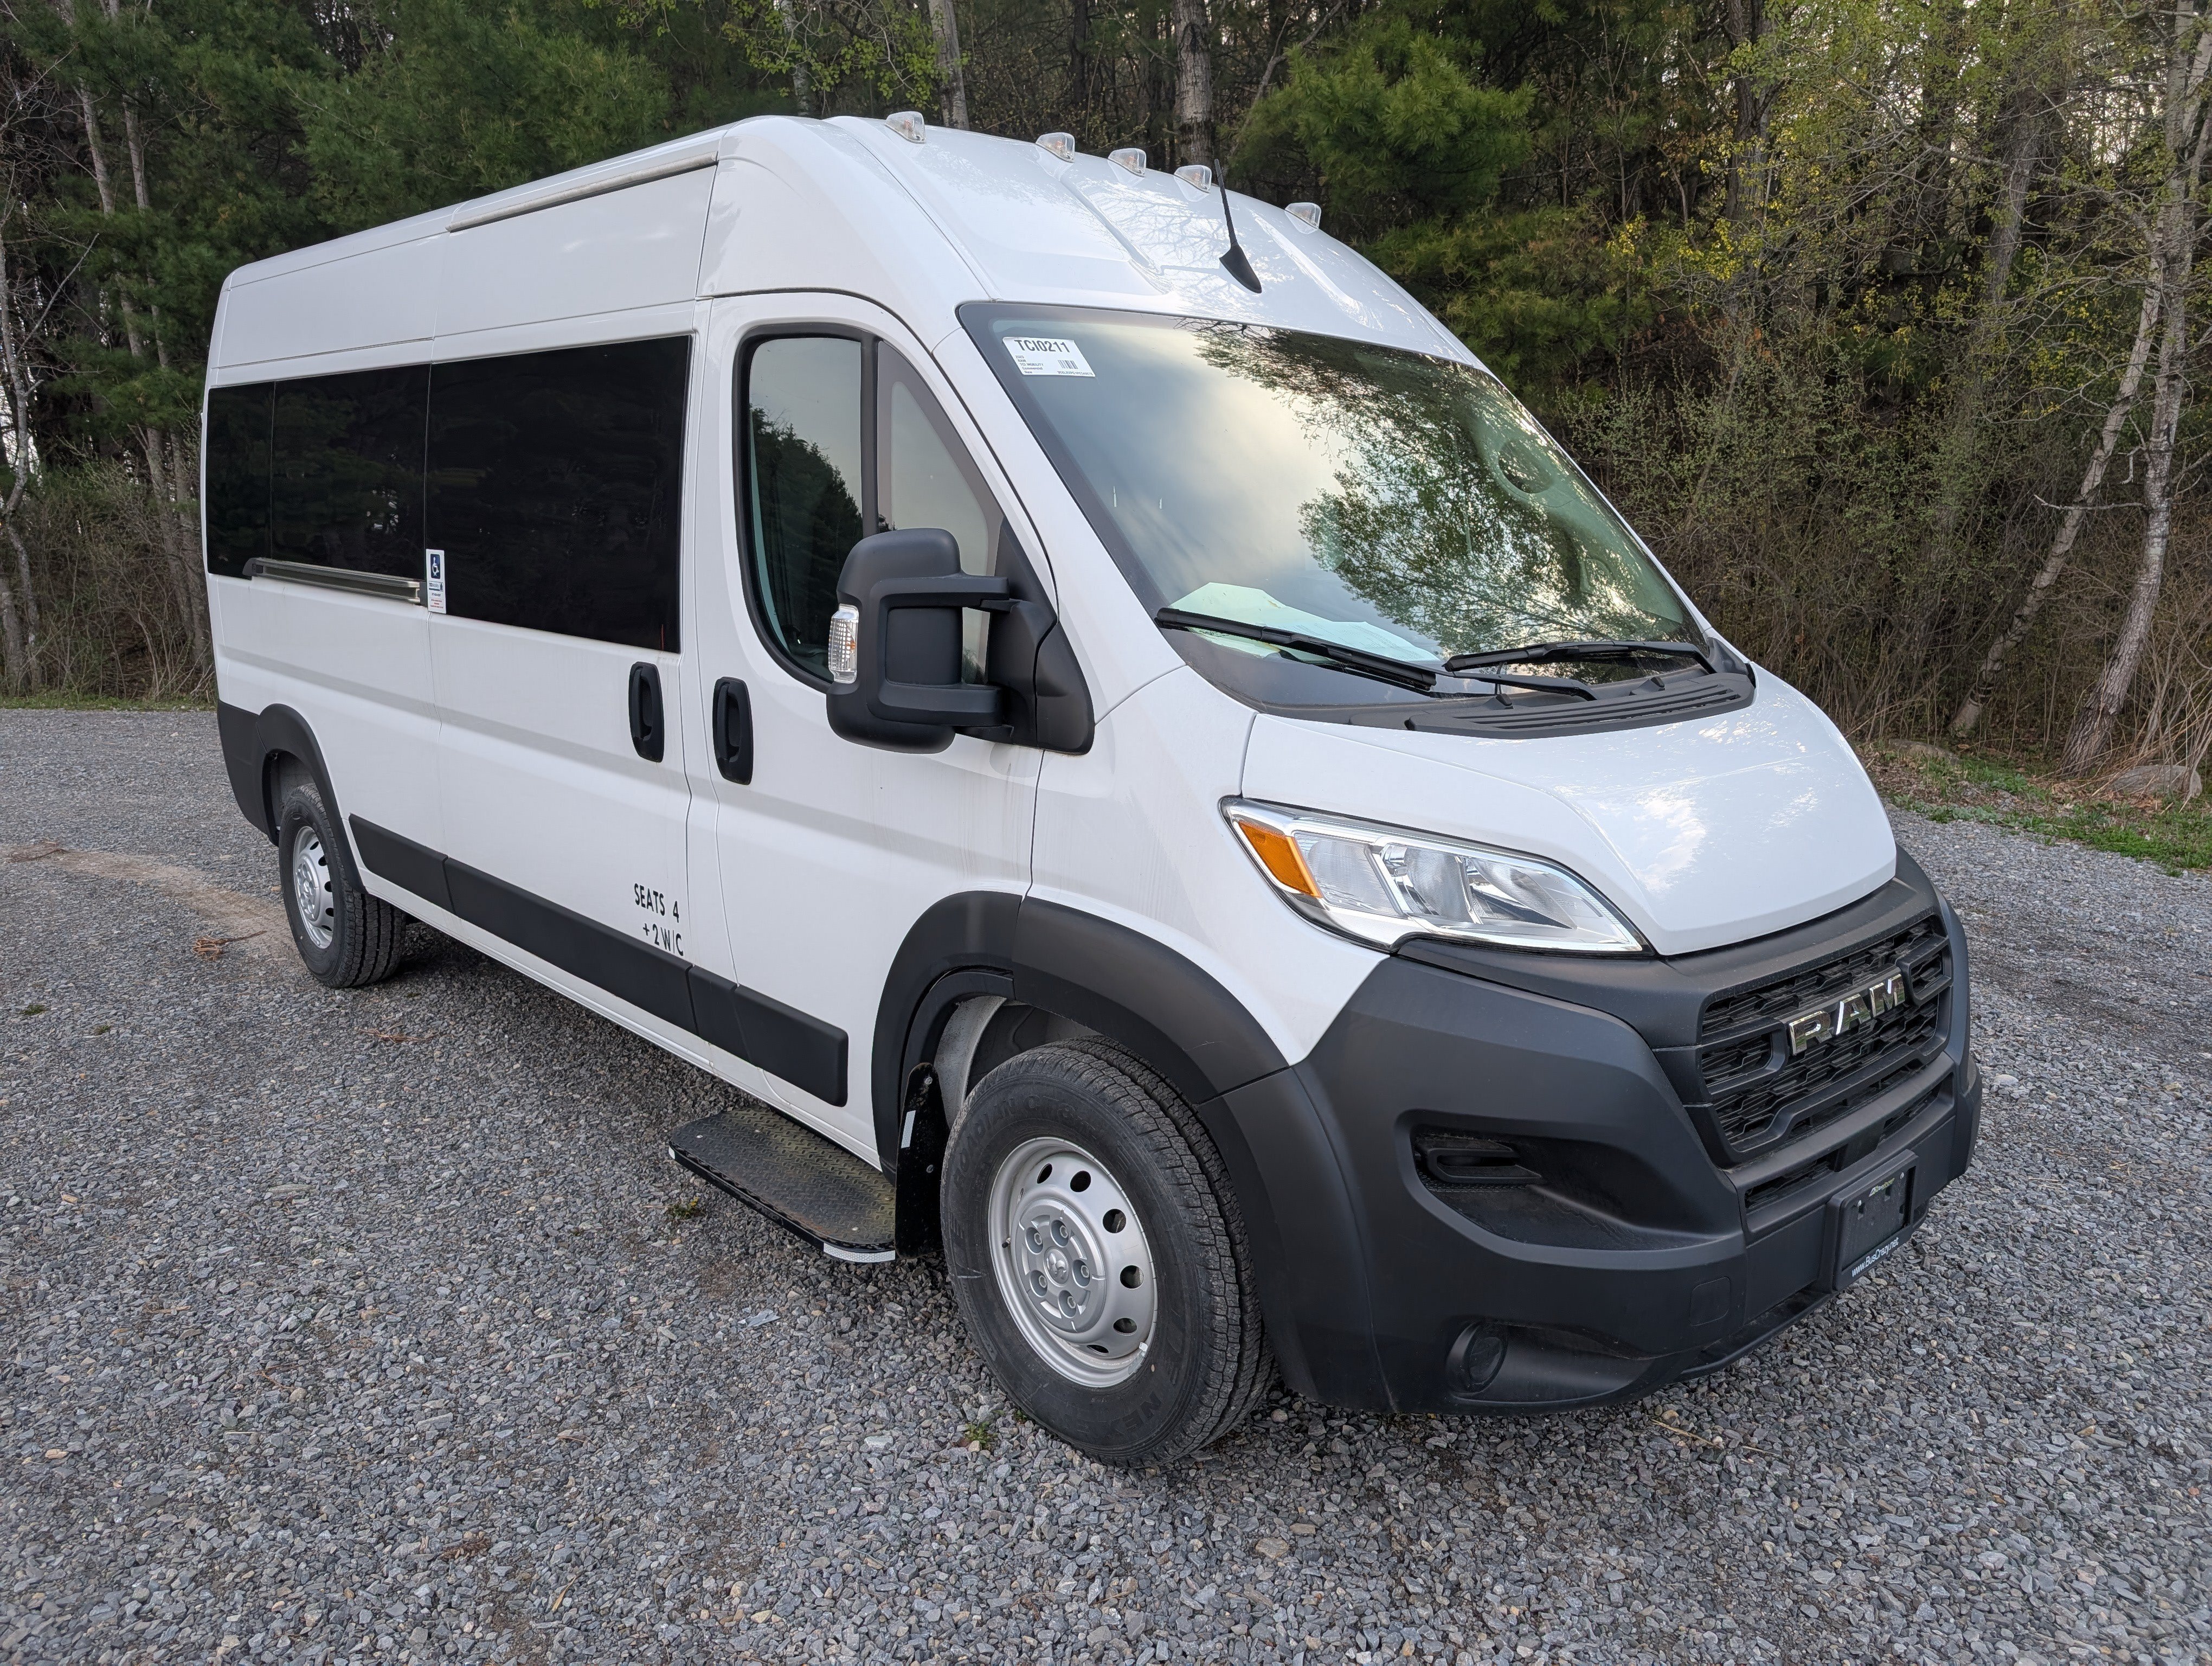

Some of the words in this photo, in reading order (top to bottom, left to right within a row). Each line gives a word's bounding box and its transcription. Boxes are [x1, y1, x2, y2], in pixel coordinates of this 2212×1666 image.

[1014, 339, 1070, 353] TCI0211
[634, 883, 665, 916] SEATS
[673, 900, 679, 924] 4
[1788, 973, 1906, 1056] RAM
